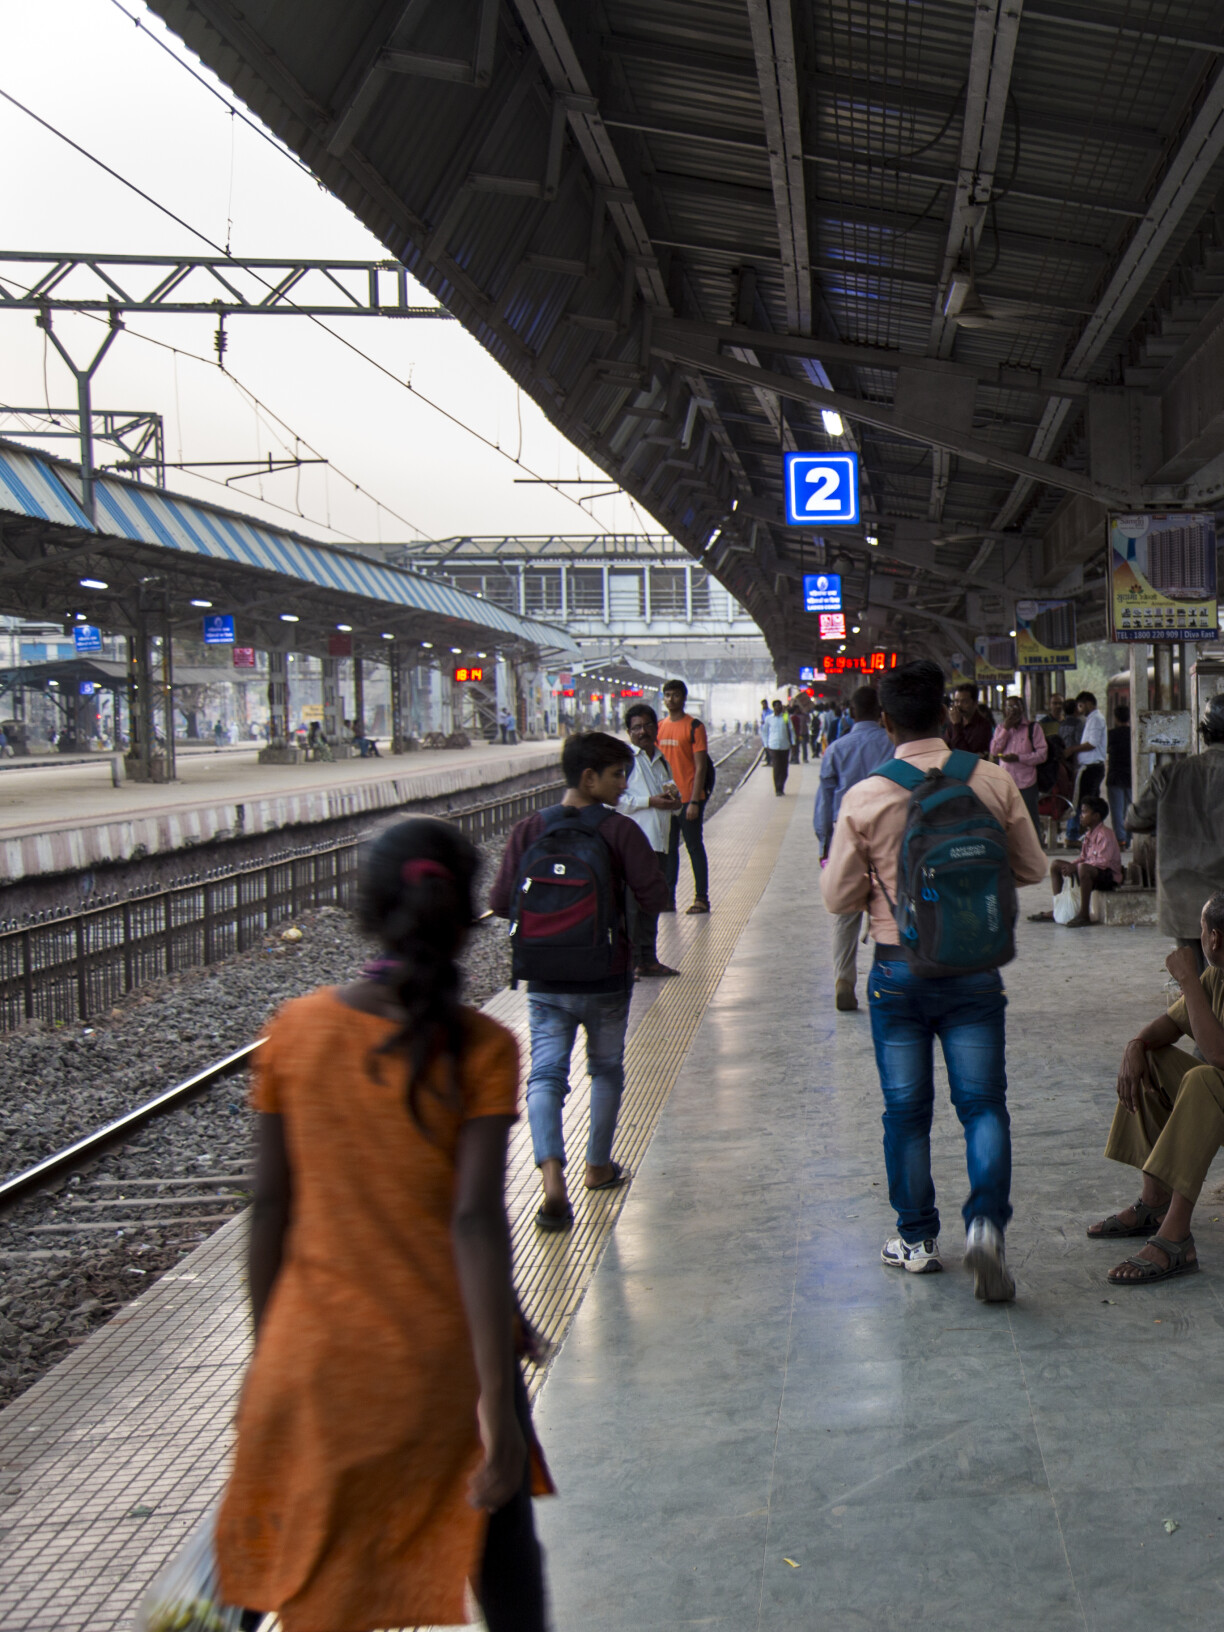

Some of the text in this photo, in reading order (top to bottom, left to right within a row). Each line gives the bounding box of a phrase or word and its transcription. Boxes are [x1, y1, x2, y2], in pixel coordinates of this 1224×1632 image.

[804, 466, 842, 511] 2
[1166, 630, 1179, 638] 909
[1184, 630, 1199, 638] Diva
[1201, 630, 1215, 638] East
